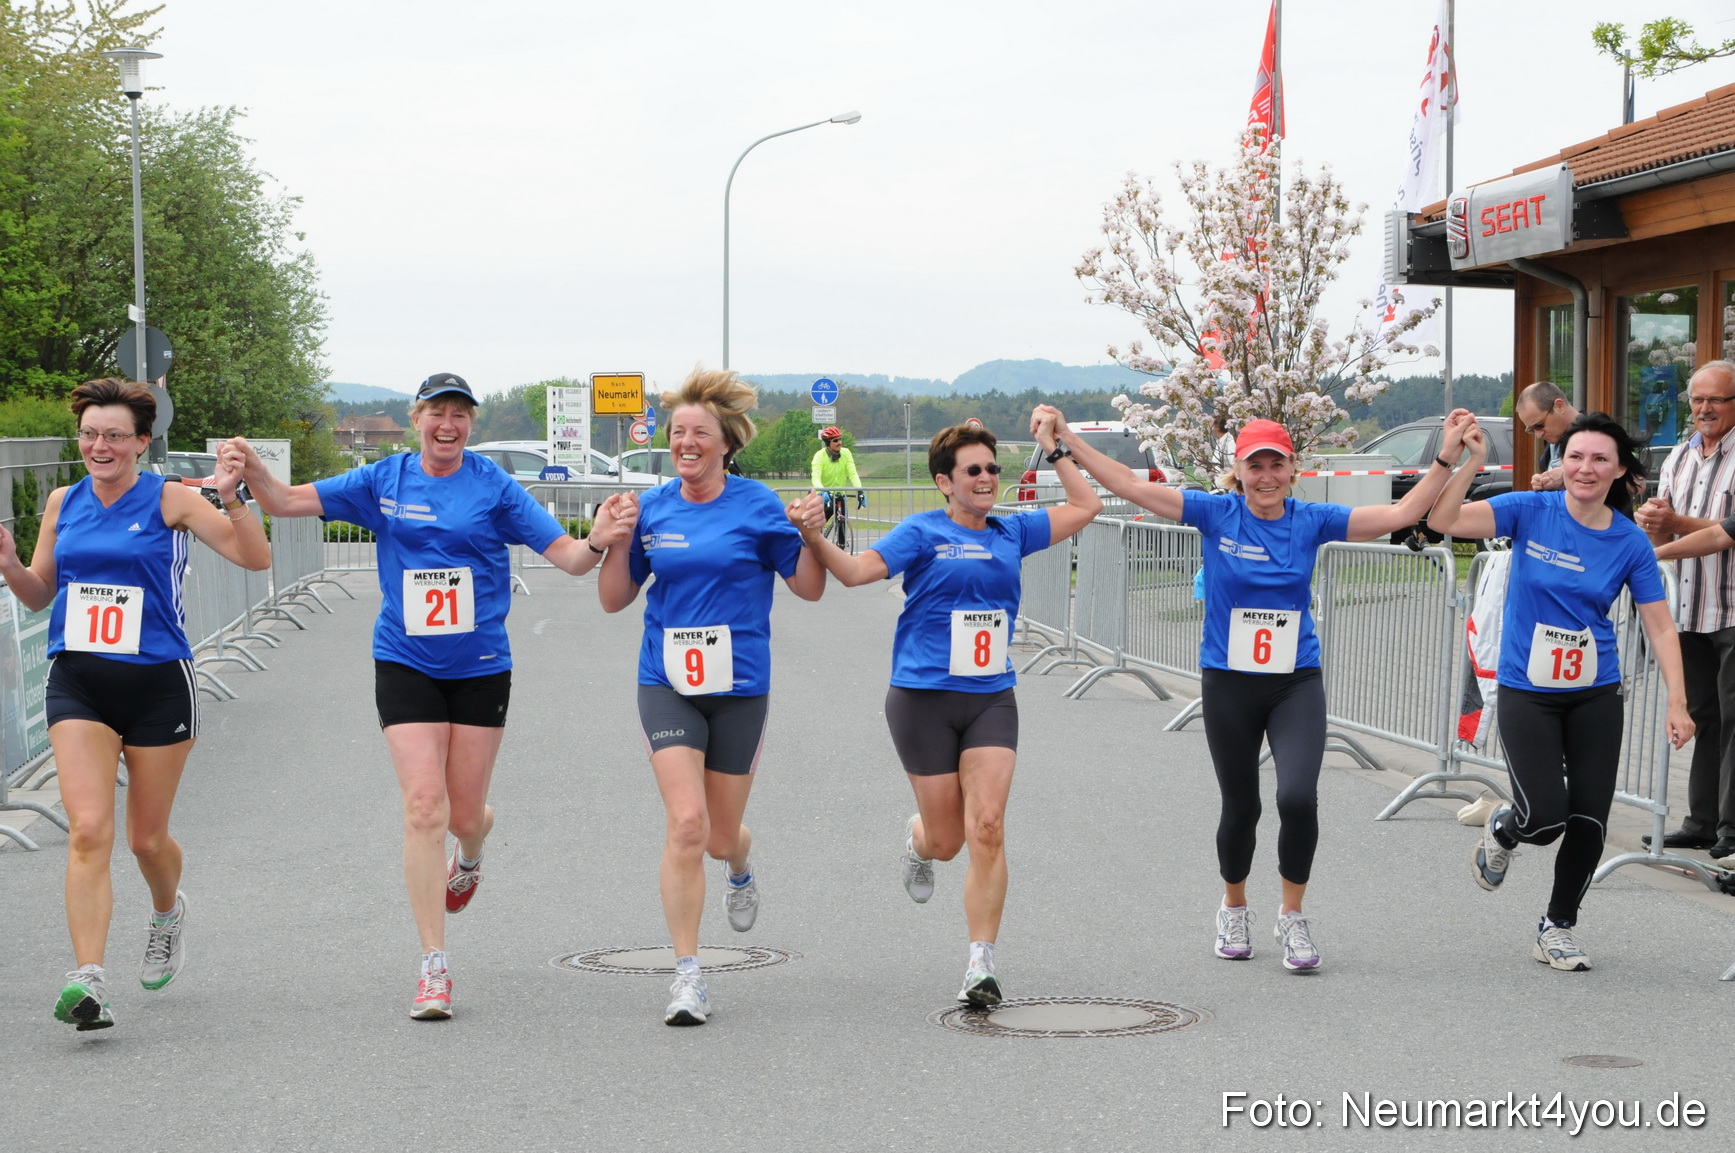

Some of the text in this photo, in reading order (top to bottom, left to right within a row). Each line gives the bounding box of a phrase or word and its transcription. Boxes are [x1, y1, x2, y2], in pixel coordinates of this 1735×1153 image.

[1481, 193, 1546, 238] SEAT
[598, 389, 639, 399] Neumarkt
[545, 472, 566, 480] VOLVO
[414, 572, 446, 580] MEYER
[80, 586, 114, 596] MEYER
[80, 595, 114, 603] WERBUNG
[425, 588, 458, 626] 21
[964, 614, 992, 622] MEYER
[1242, 612, 1274, 620] MEYER
[87, 605, 124, 645] 10
[673, 631, 703, 640] MEYER
[1546, 630, 1577, 642] MEYER
[1253, 628, 1272, 665] 6
[1544, 637, 1578, 648] WERBUNG
[974, 630, 991, 668] 8
[685, 648, 705, 687] 9
[1551, 648, 1584, 682] 13
[652, 729, 685, 740] ODLO
